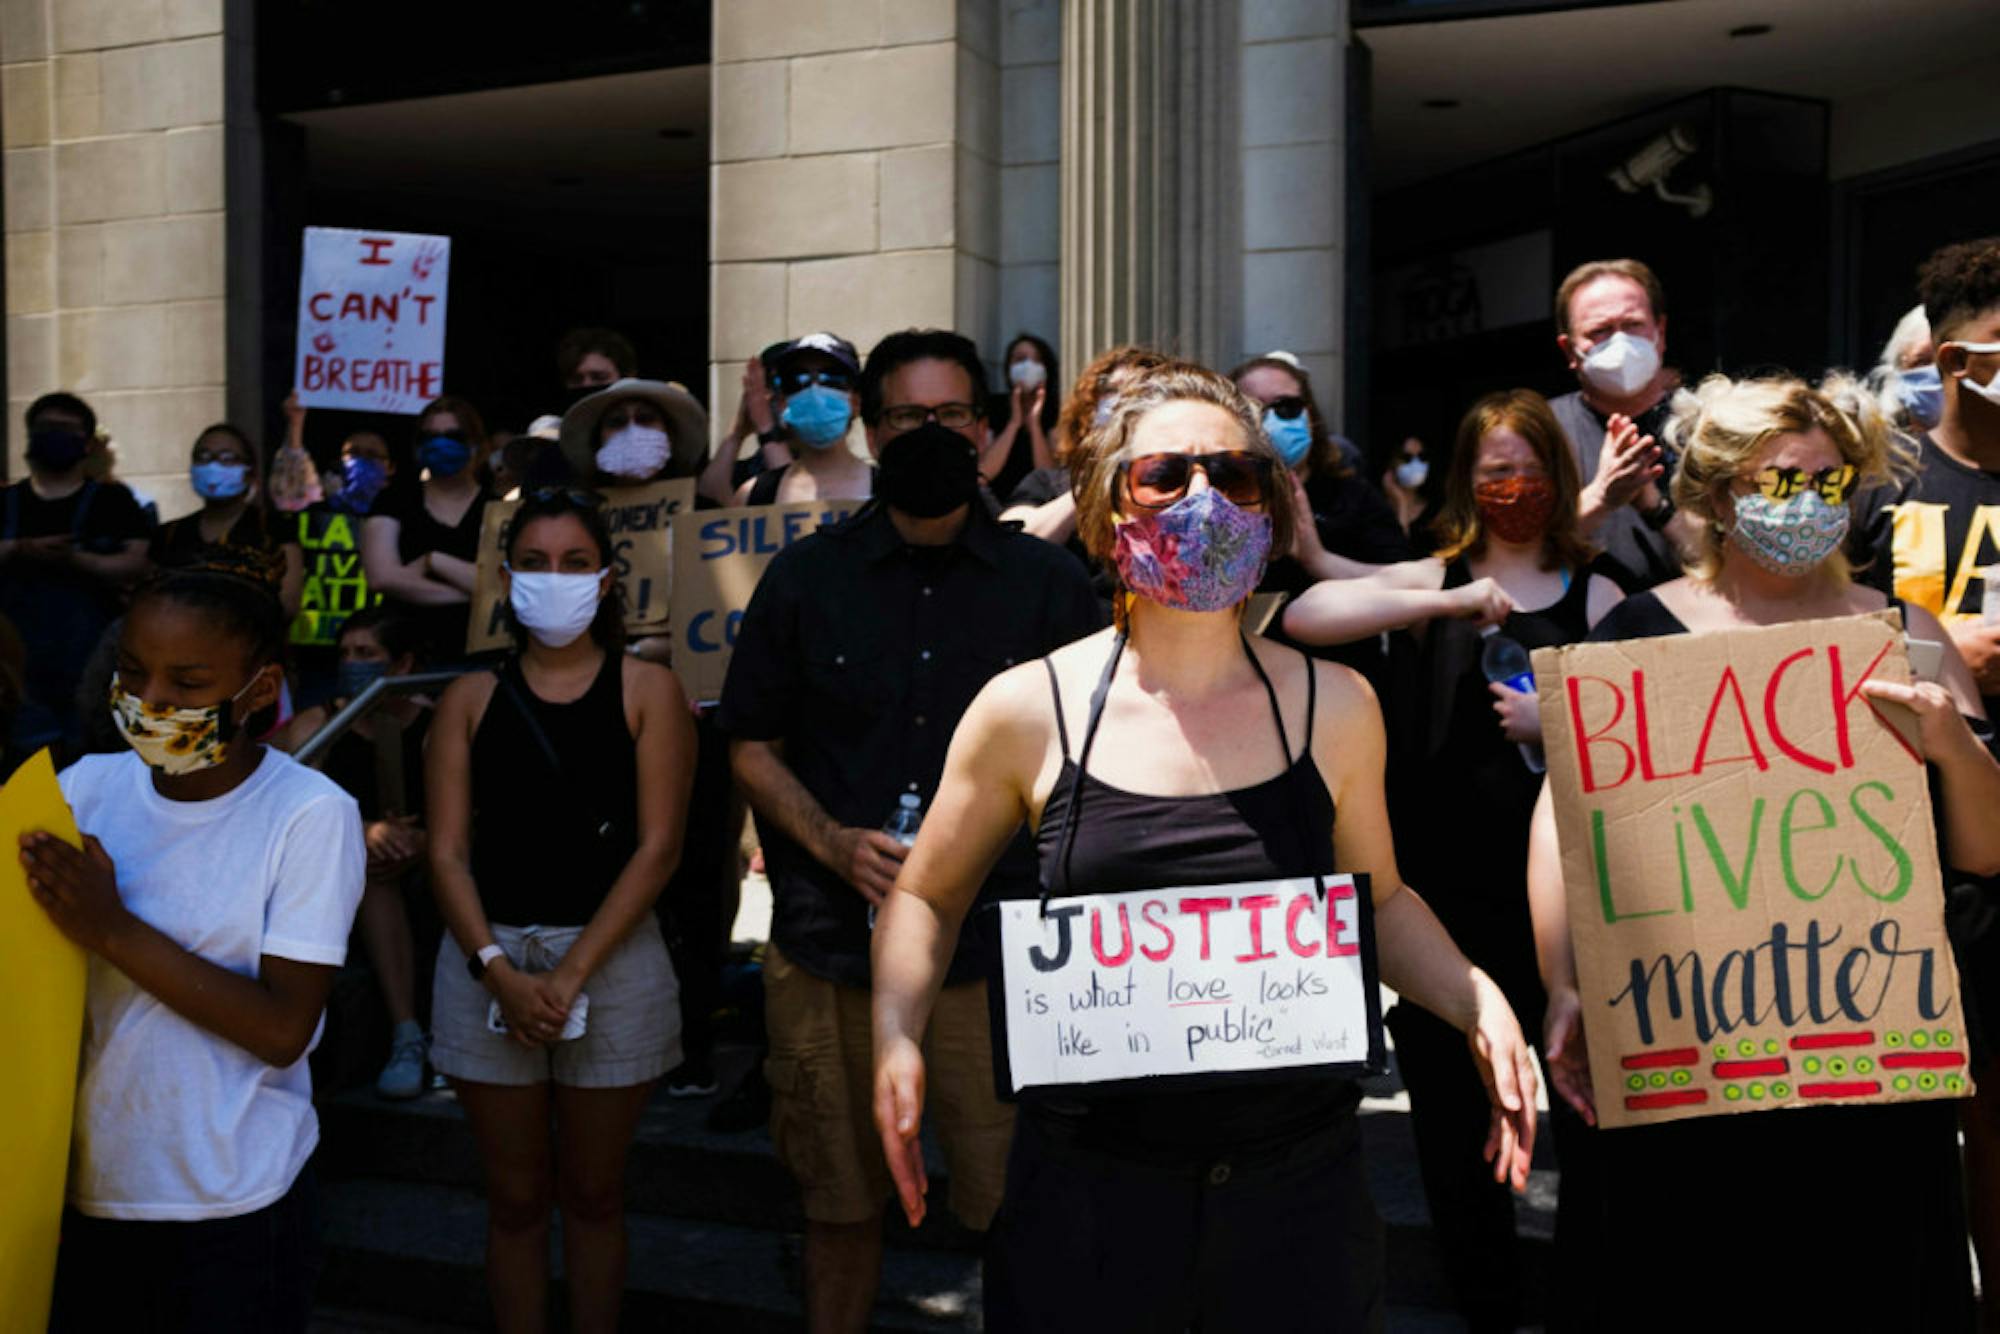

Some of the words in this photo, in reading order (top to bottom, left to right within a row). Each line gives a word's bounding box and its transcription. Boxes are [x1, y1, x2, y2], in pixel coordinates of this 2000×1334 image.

[358, 238, 394, 265] I
[309, 286, 435, 324] CAN'T
[303, 354, 440, 399] BREATHE
[1566, 639, 1925, 794] BLACK
[1028, 884, 1360, 973] JUSTICE
[1024, 988, 1049, 1015] is
[1069, 968, 1137, 1008] what
[1167, 966, 1232, 1001] love
[1259, 970, 1329, 1005] looks
[1608, 919, 1952, 1045] matter
[1057, 1018, 1099, 1057] like
[1127, 1023, 1150, 1053] in
